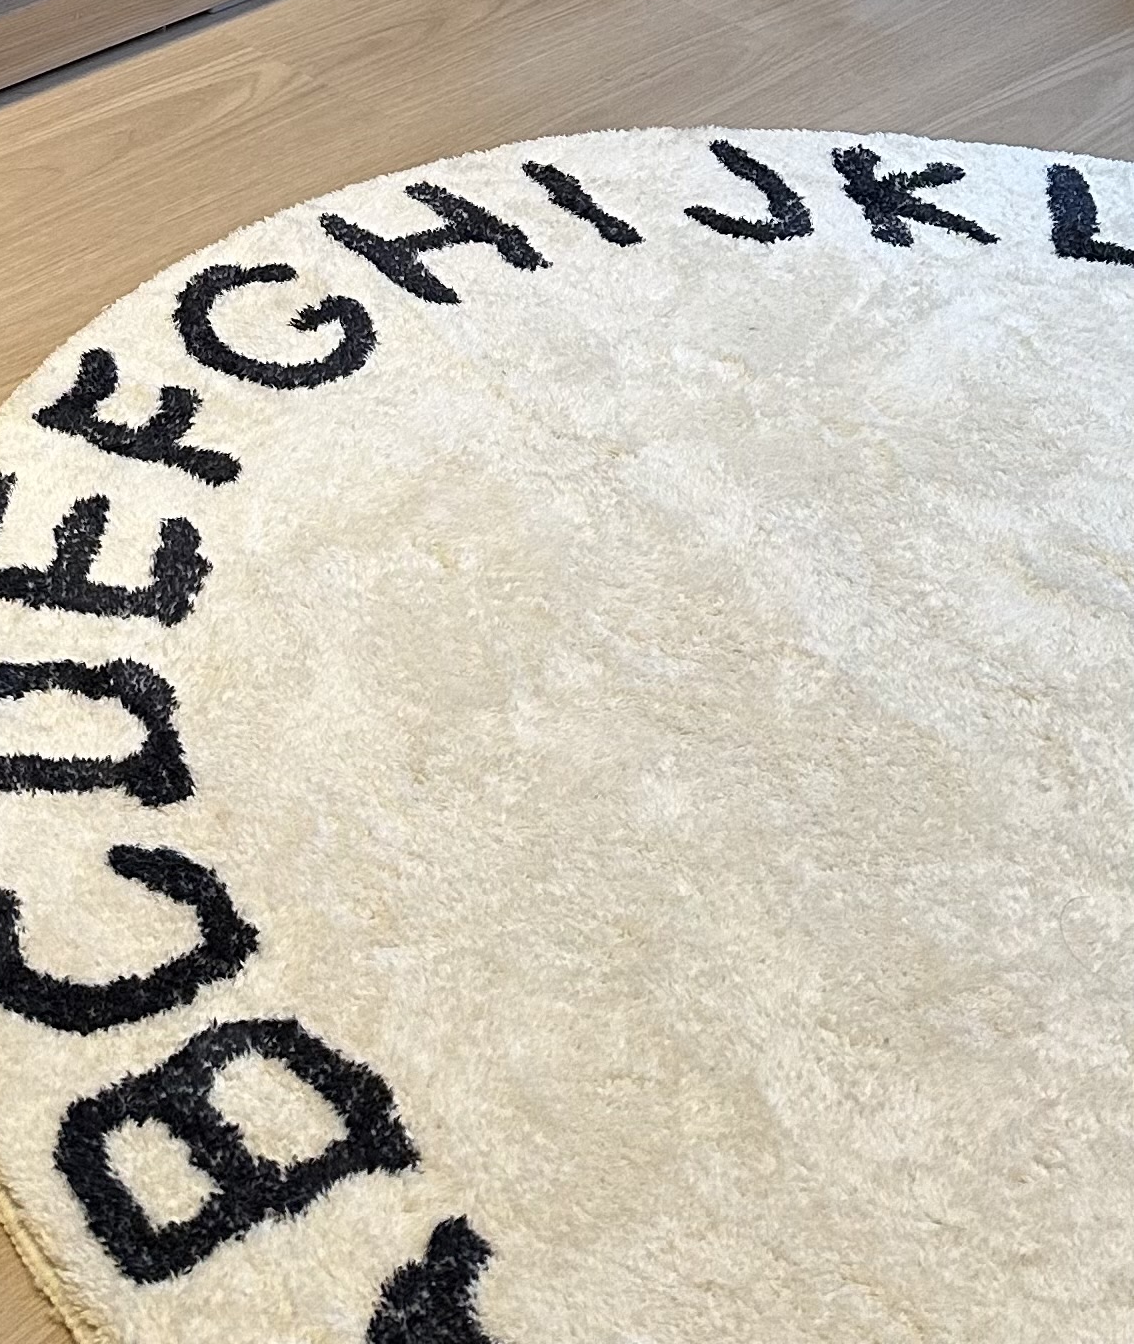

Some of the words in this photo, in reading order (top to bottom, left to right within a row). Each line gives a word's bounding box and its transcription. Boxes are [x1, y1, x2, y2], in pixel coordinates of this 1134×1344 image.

[319, 182, 552, 304] H
[522, 160, 643, 247] I
[684, 140, 815, 243] J
[831, 144, 999, 247] K
[172, 264, 377, 390] G
[32, 348, 241, 487] F
[53, 1019, 421, 1285] B
